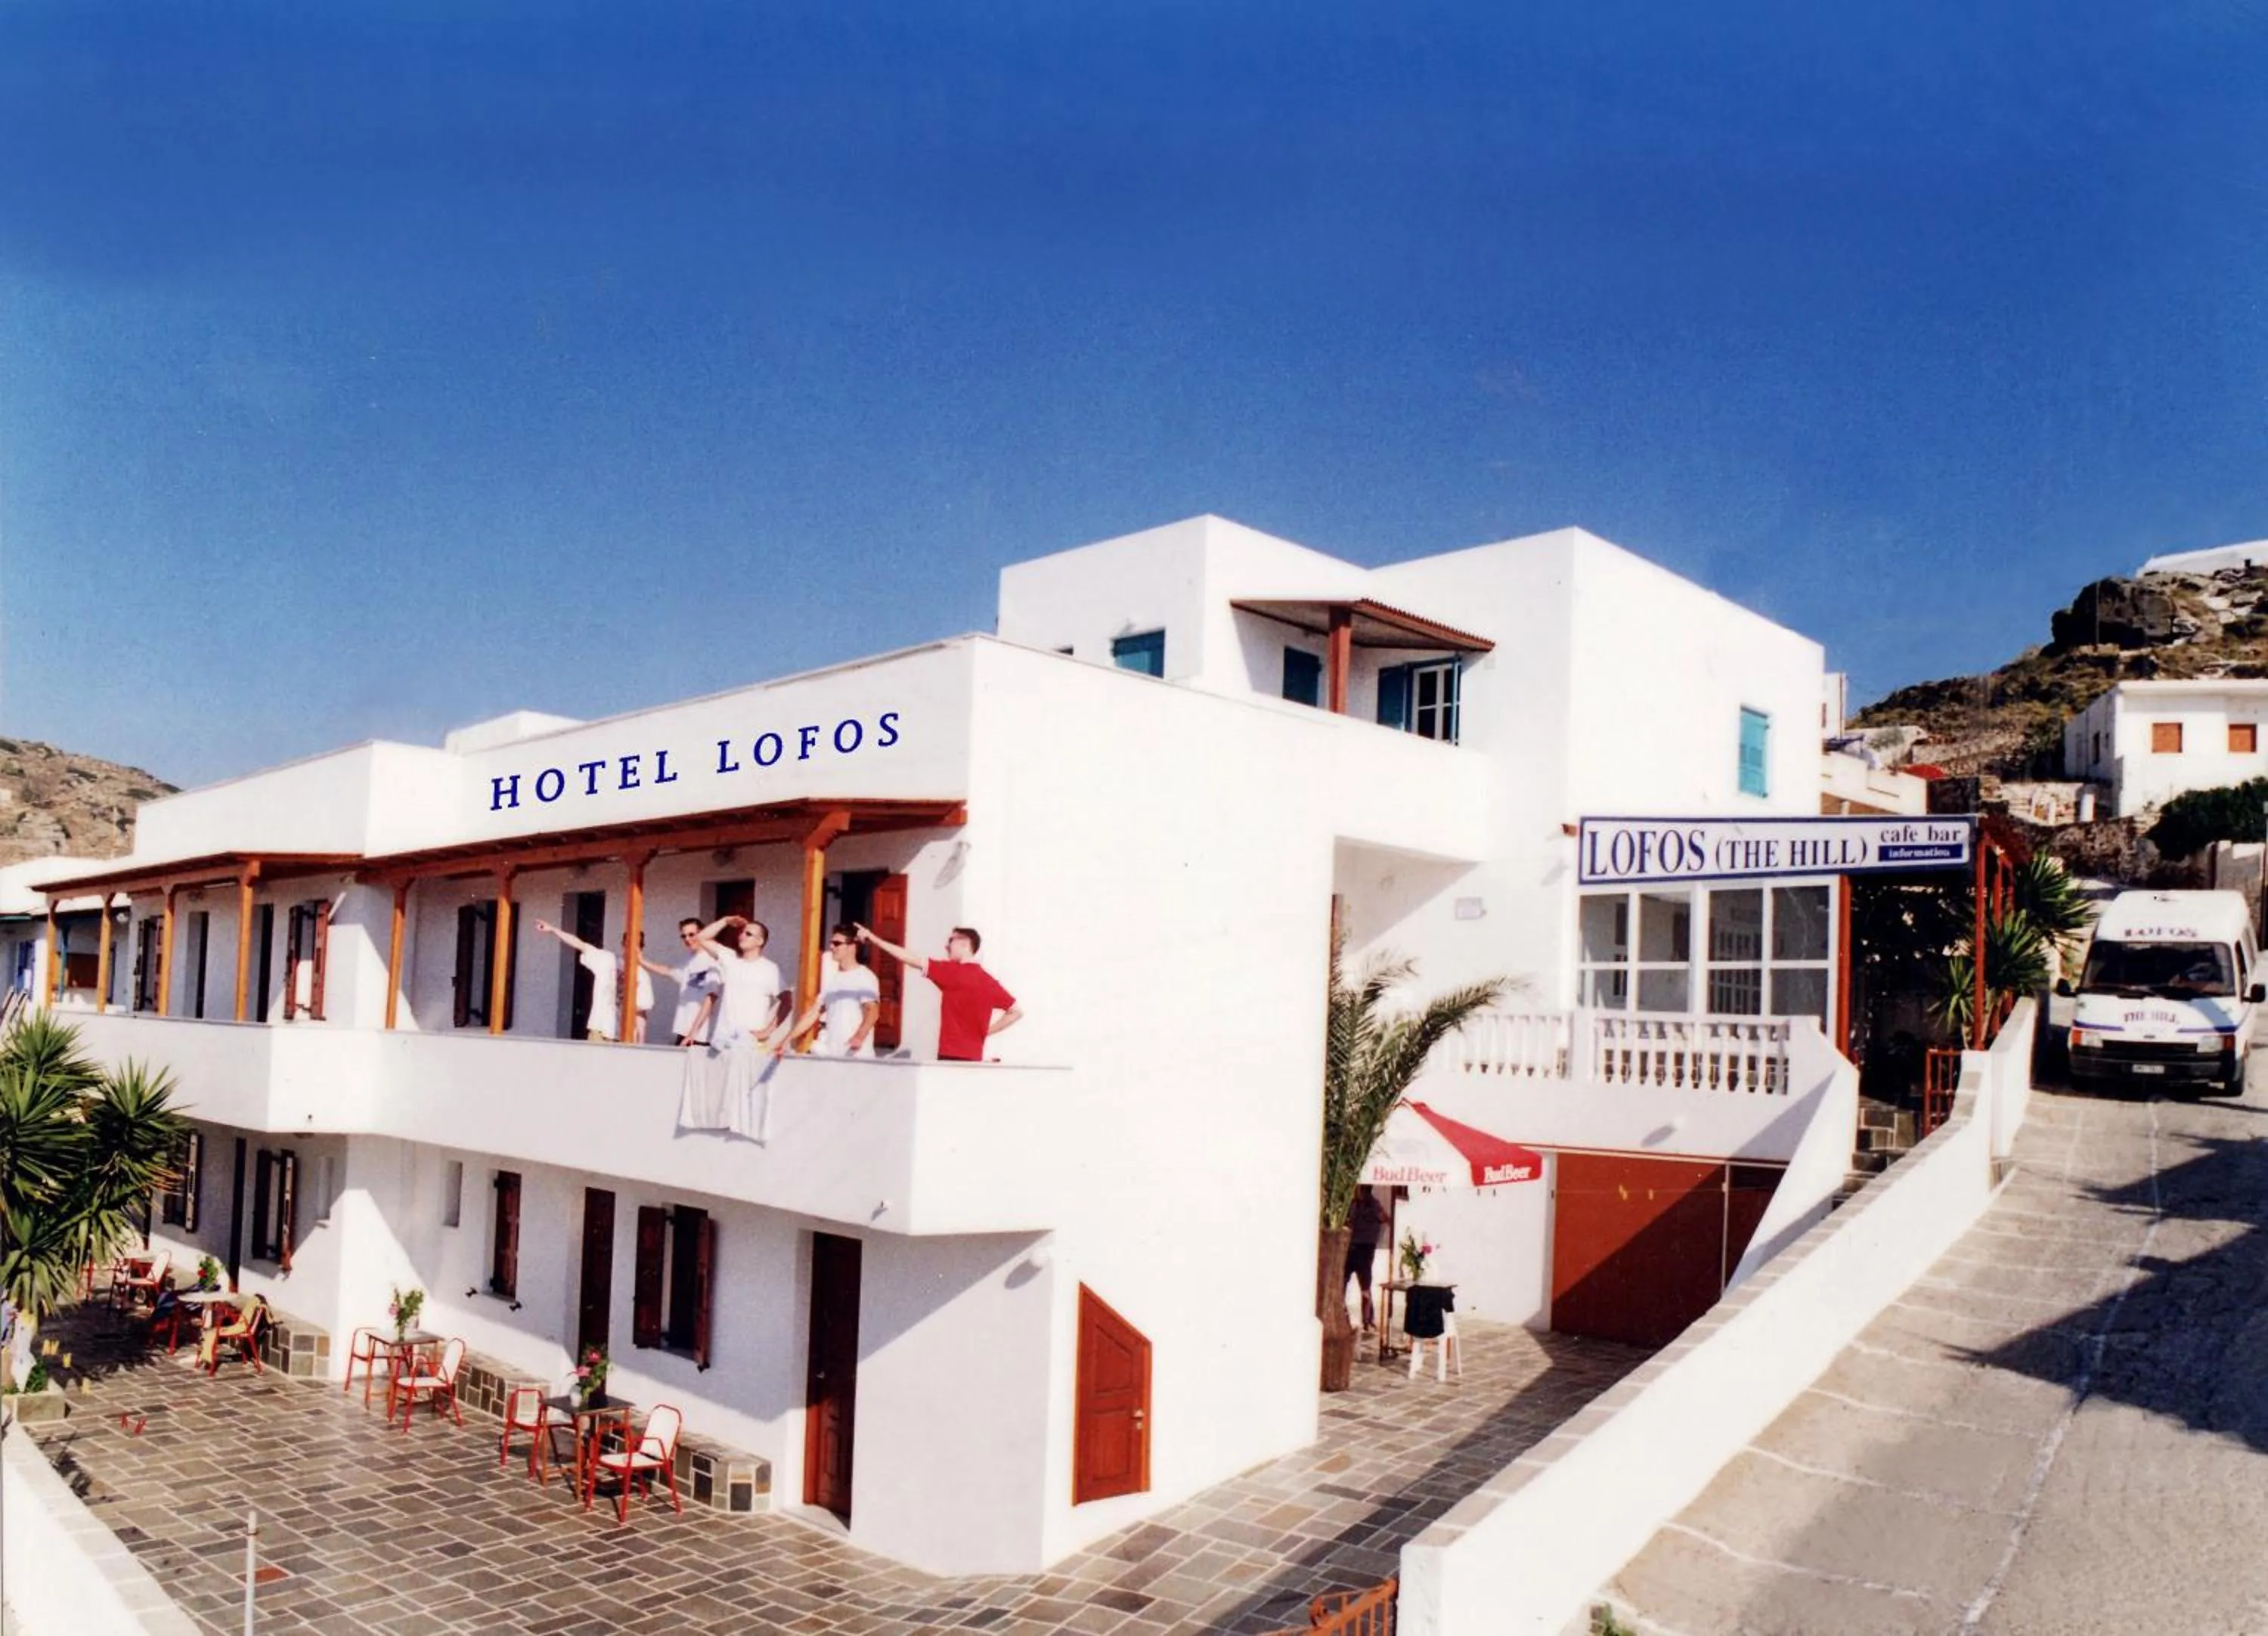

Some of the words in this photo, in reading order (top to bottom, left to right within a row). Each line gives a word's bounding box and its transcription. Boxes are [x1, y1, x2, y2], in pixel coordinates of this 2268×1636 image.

[490, 751, 677, 810] HOTEL
[717, 712, 900, 773] LOFOS
[1880, 824, 1919, 843] cafe
[1927, 825, 1962, 841] bar
[1588, 830, 1706, 876] LOFOS
[1715, 838, 1779, 871] (THE
[1789, 835, 1868, 866] HILL)
[1888, 847, 1950, 858] information
